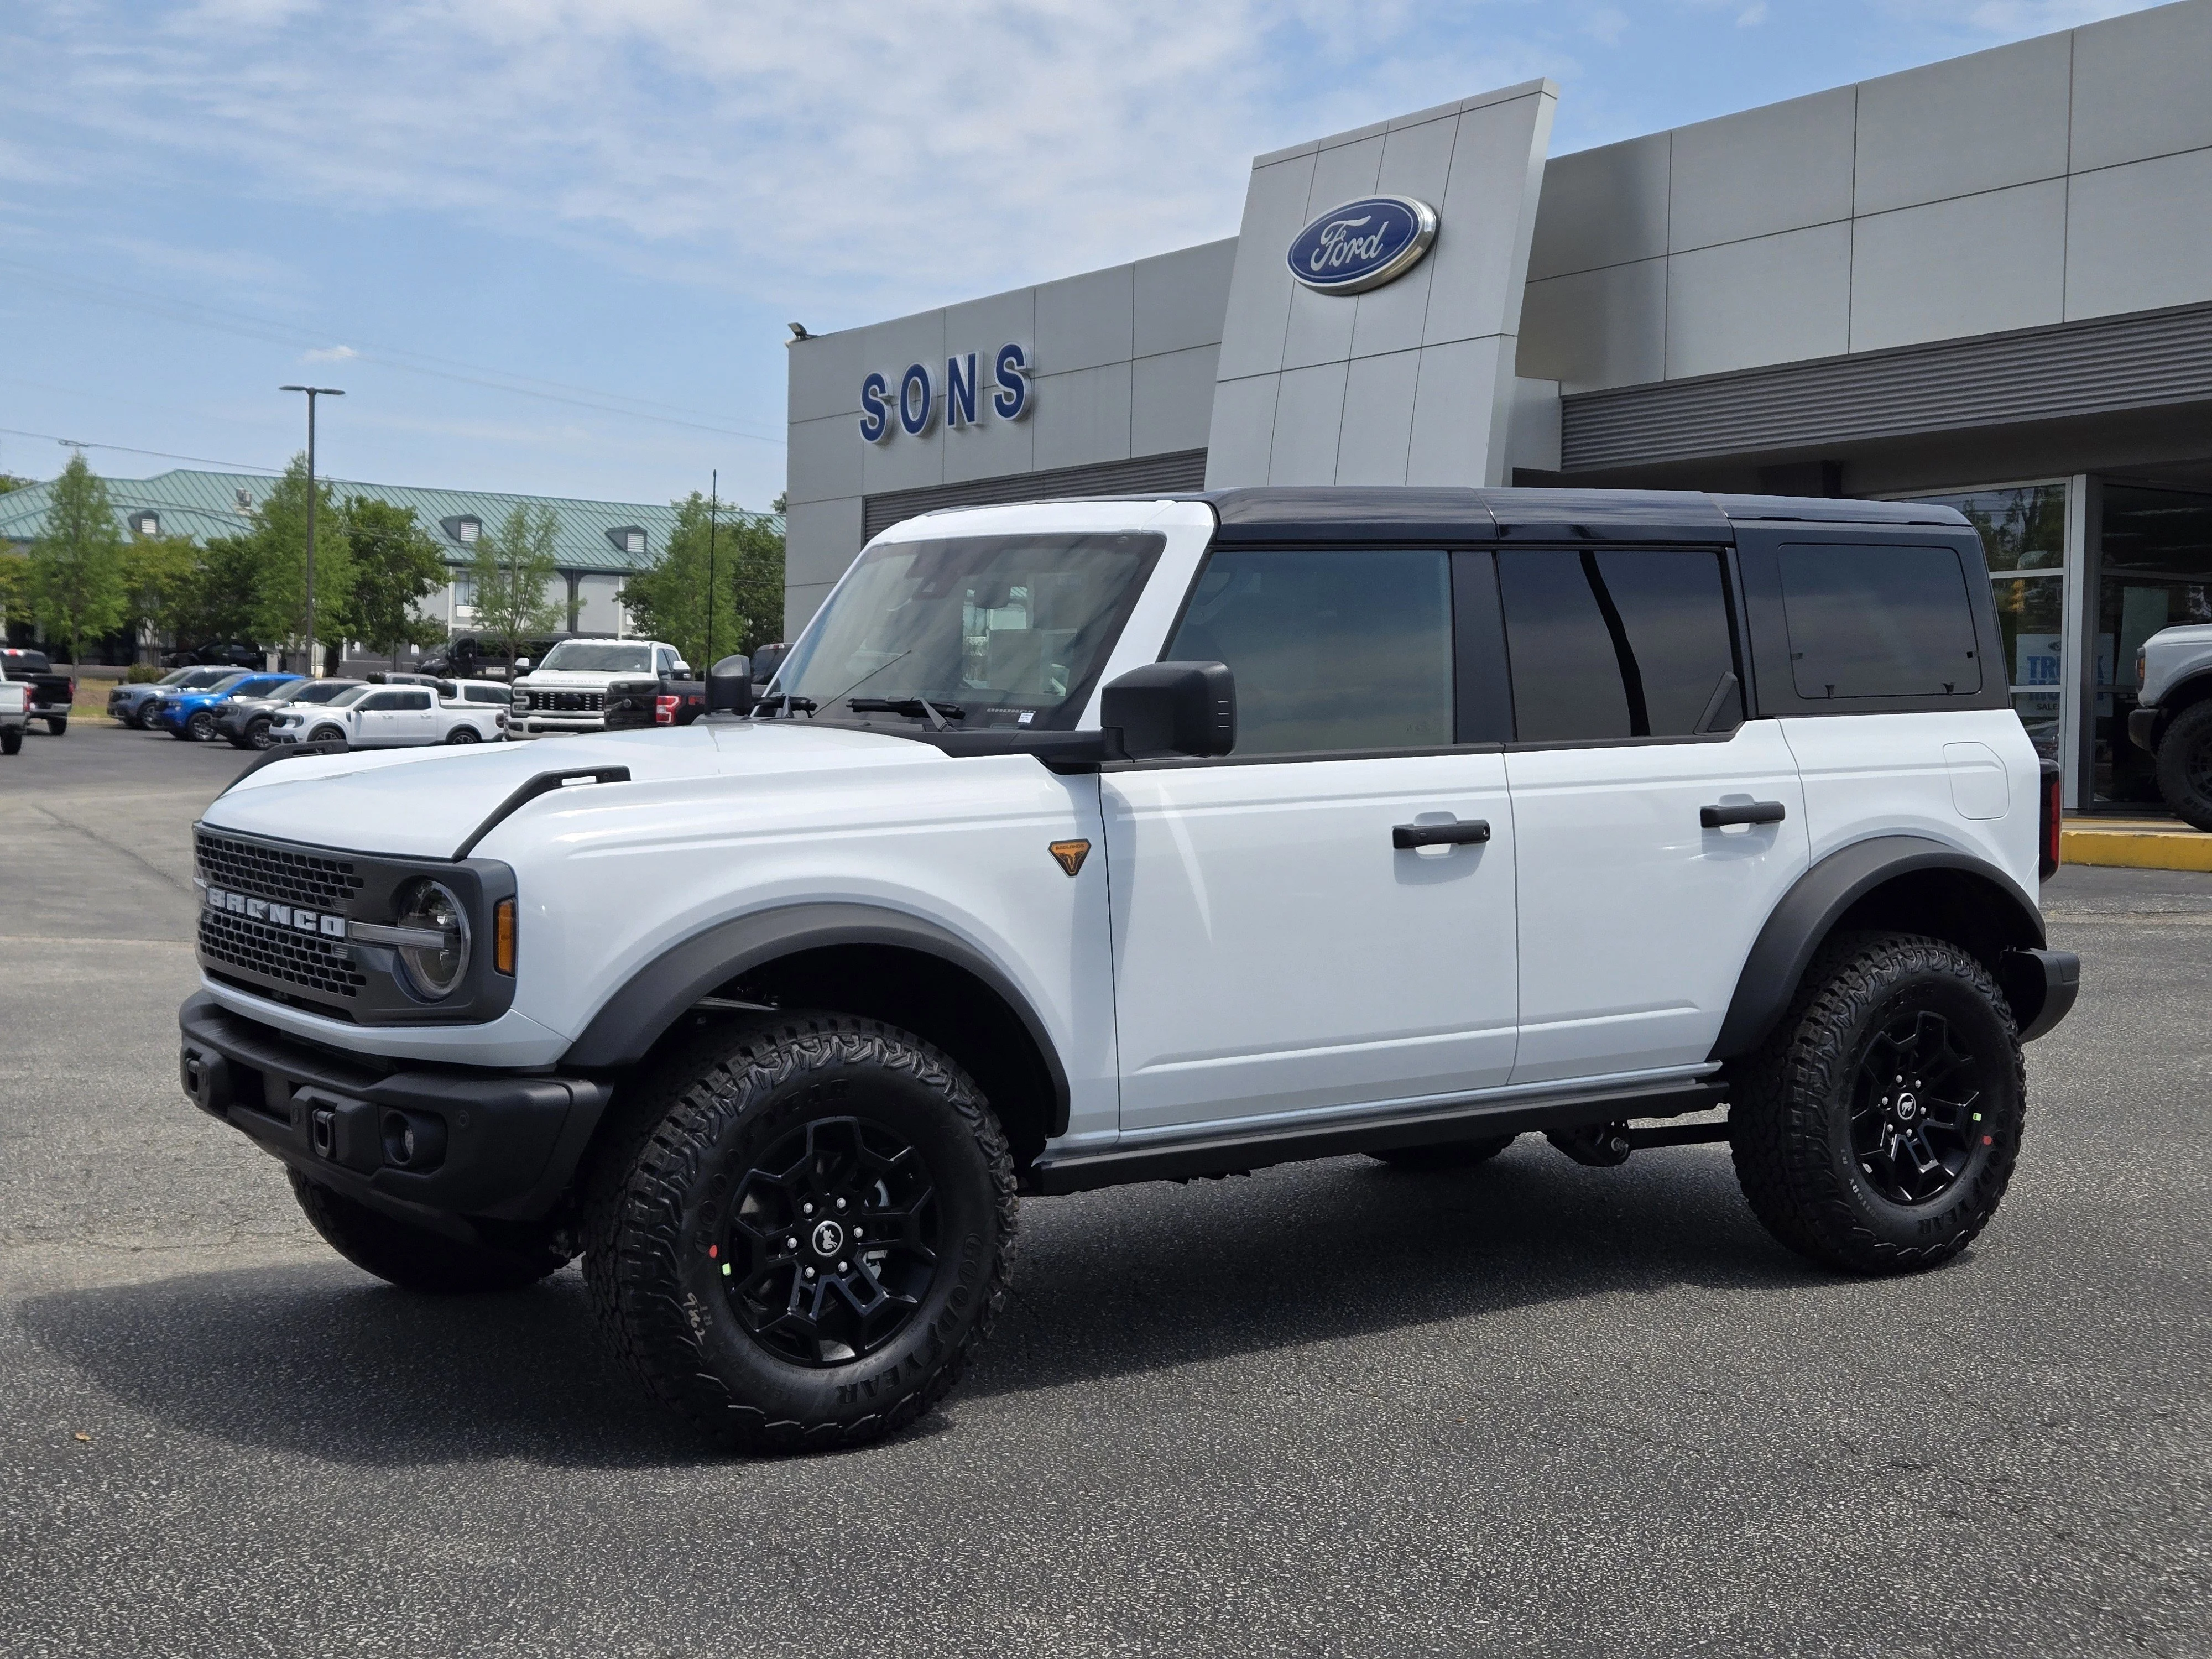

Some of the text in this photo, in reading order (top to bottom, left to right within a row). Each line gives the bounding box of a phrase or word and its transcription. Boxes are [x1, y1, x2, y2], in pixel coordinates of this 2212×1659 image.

[1311, 215, 1389, 271] Ford
[859, 342, 1032, 443] SONS
[208, 888, 345, 937] BRONCO
